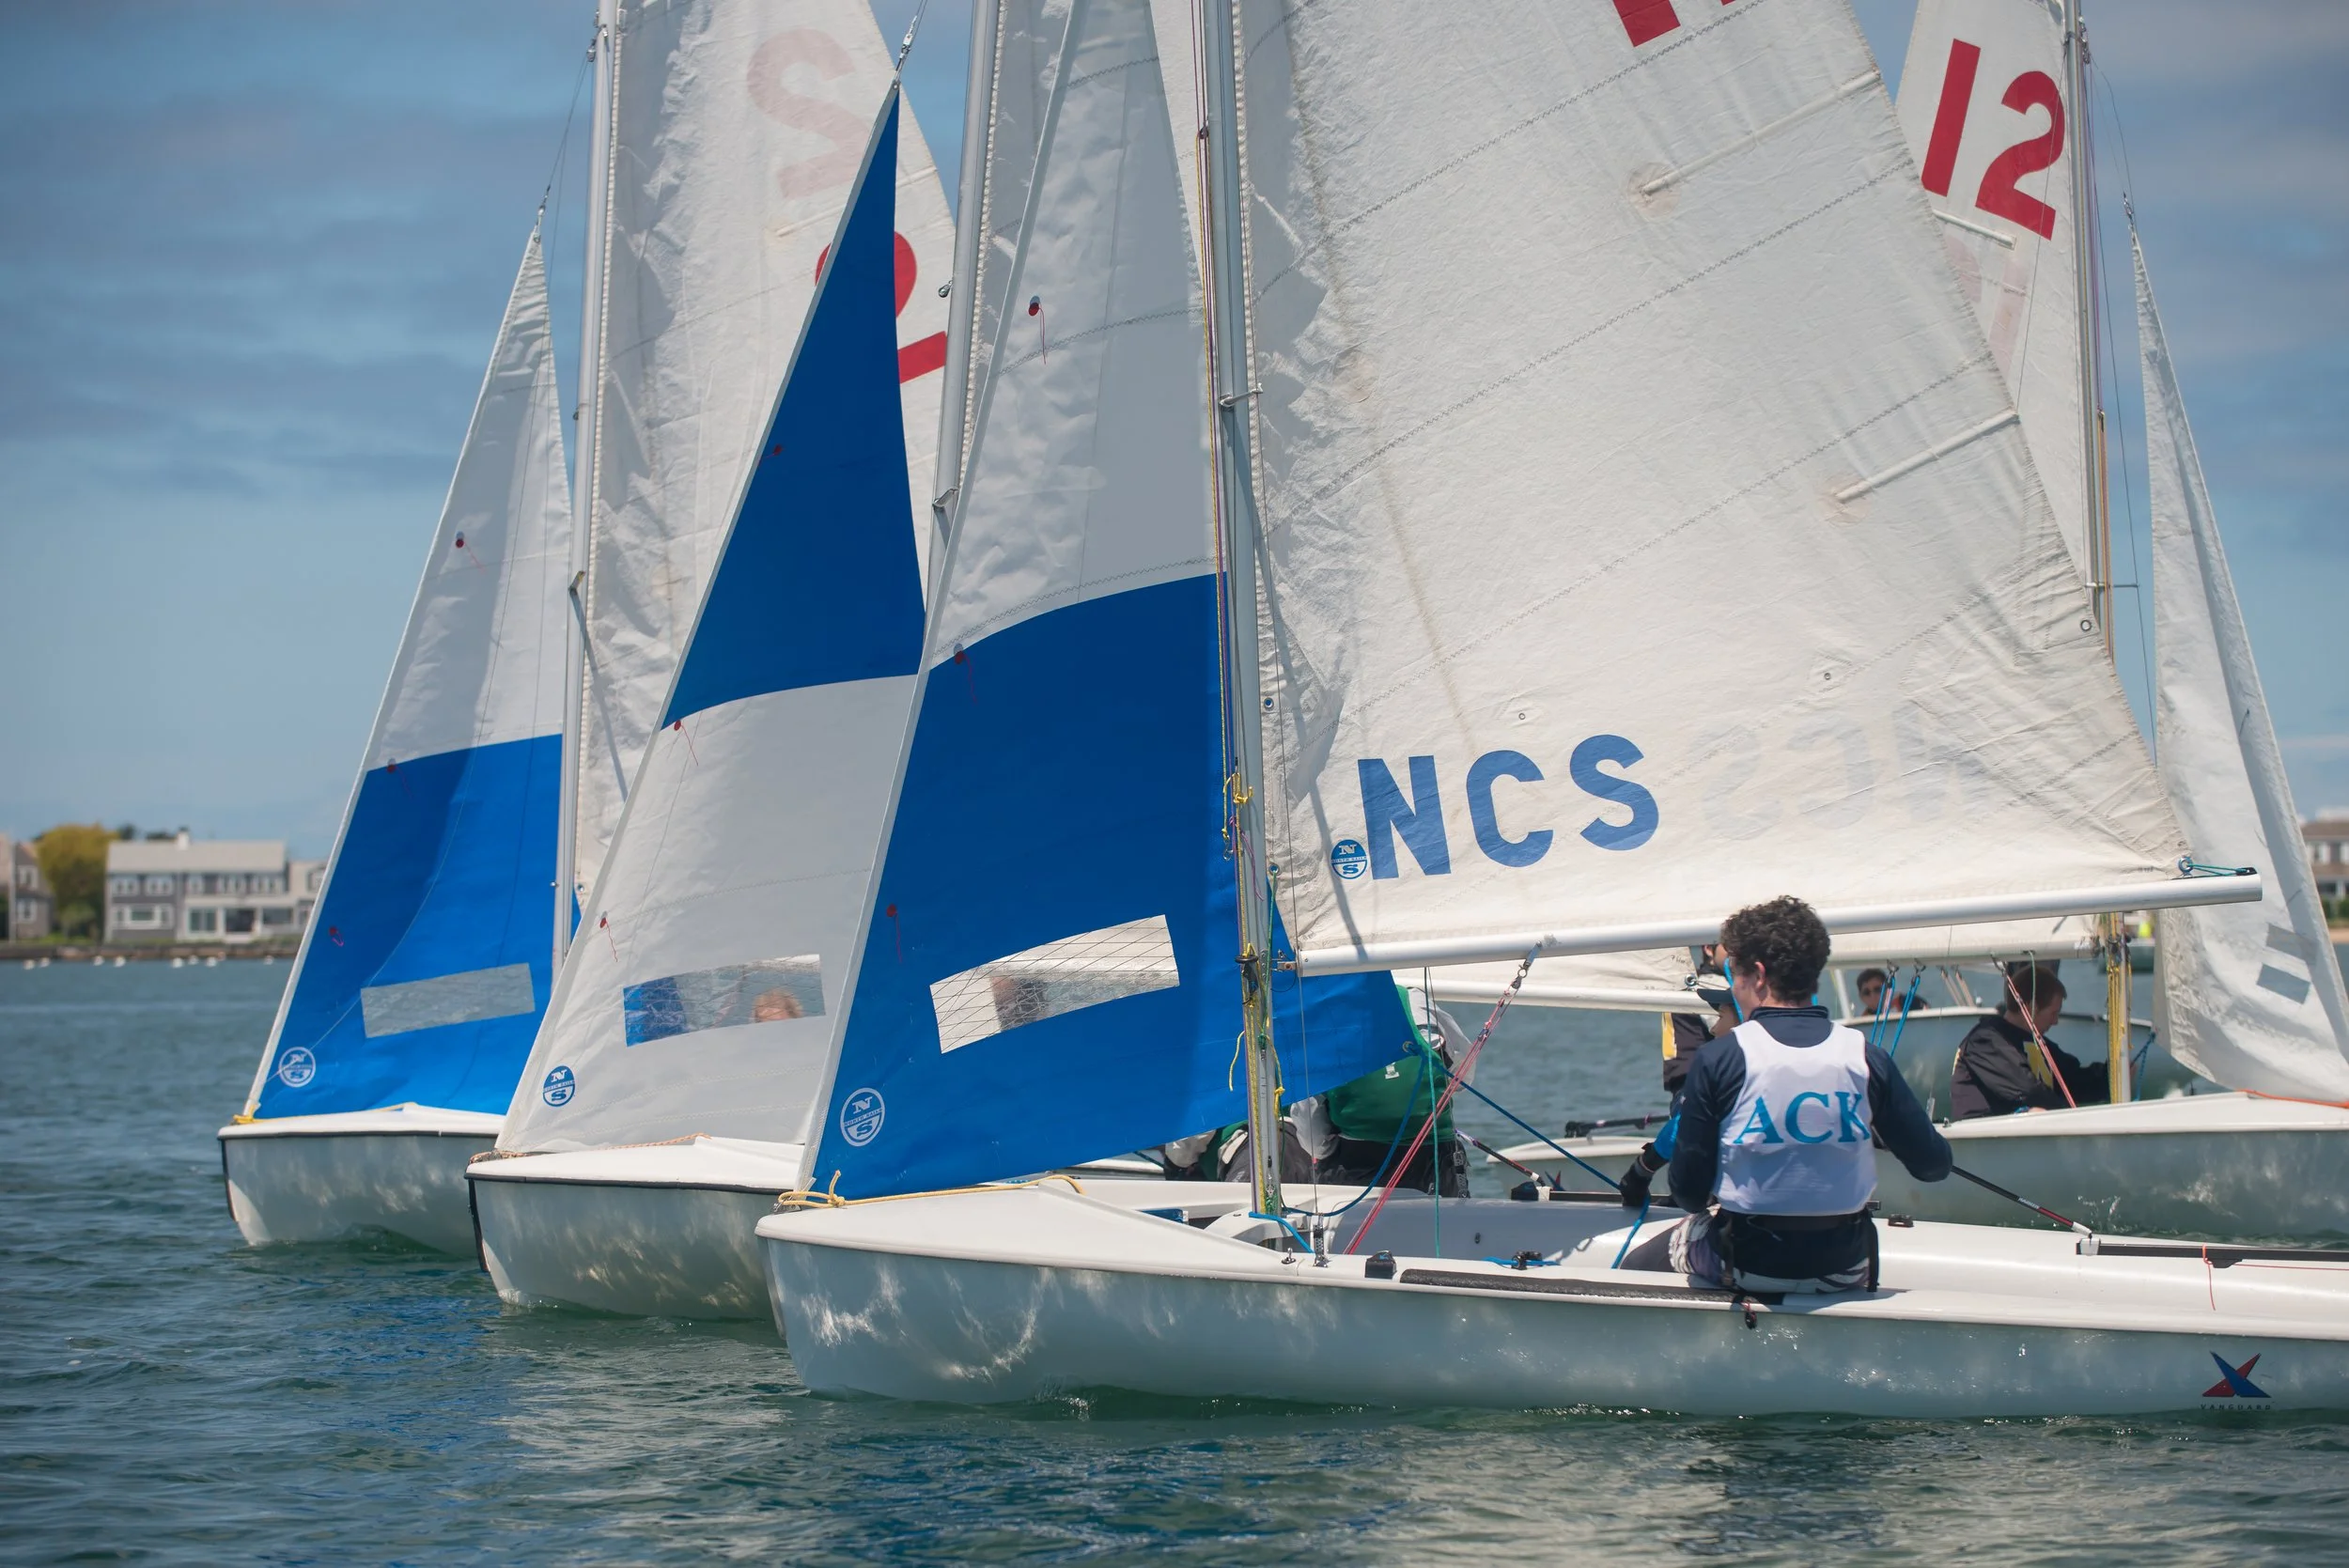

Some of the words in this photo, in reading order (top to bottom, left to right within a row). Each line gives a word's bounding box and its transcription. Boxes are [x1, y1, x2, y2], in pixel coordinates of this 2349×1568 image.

[1921, 39, 2065, 241] 12
[1358, 734, 1659, 879] NCS
[1339, 844, 1357, 855] N
[1342, 863, 1359, 875] S
[551, 1069, 567, 1082] N
[551, 1089, 567, 1102] S
[852, 1096, 872, 1114] N
[1733, 1091, 1871, 1144] ACK
[856, 1119, 873, 1138] S
[2200, 1403, 2271, 1411] VANGUARD
